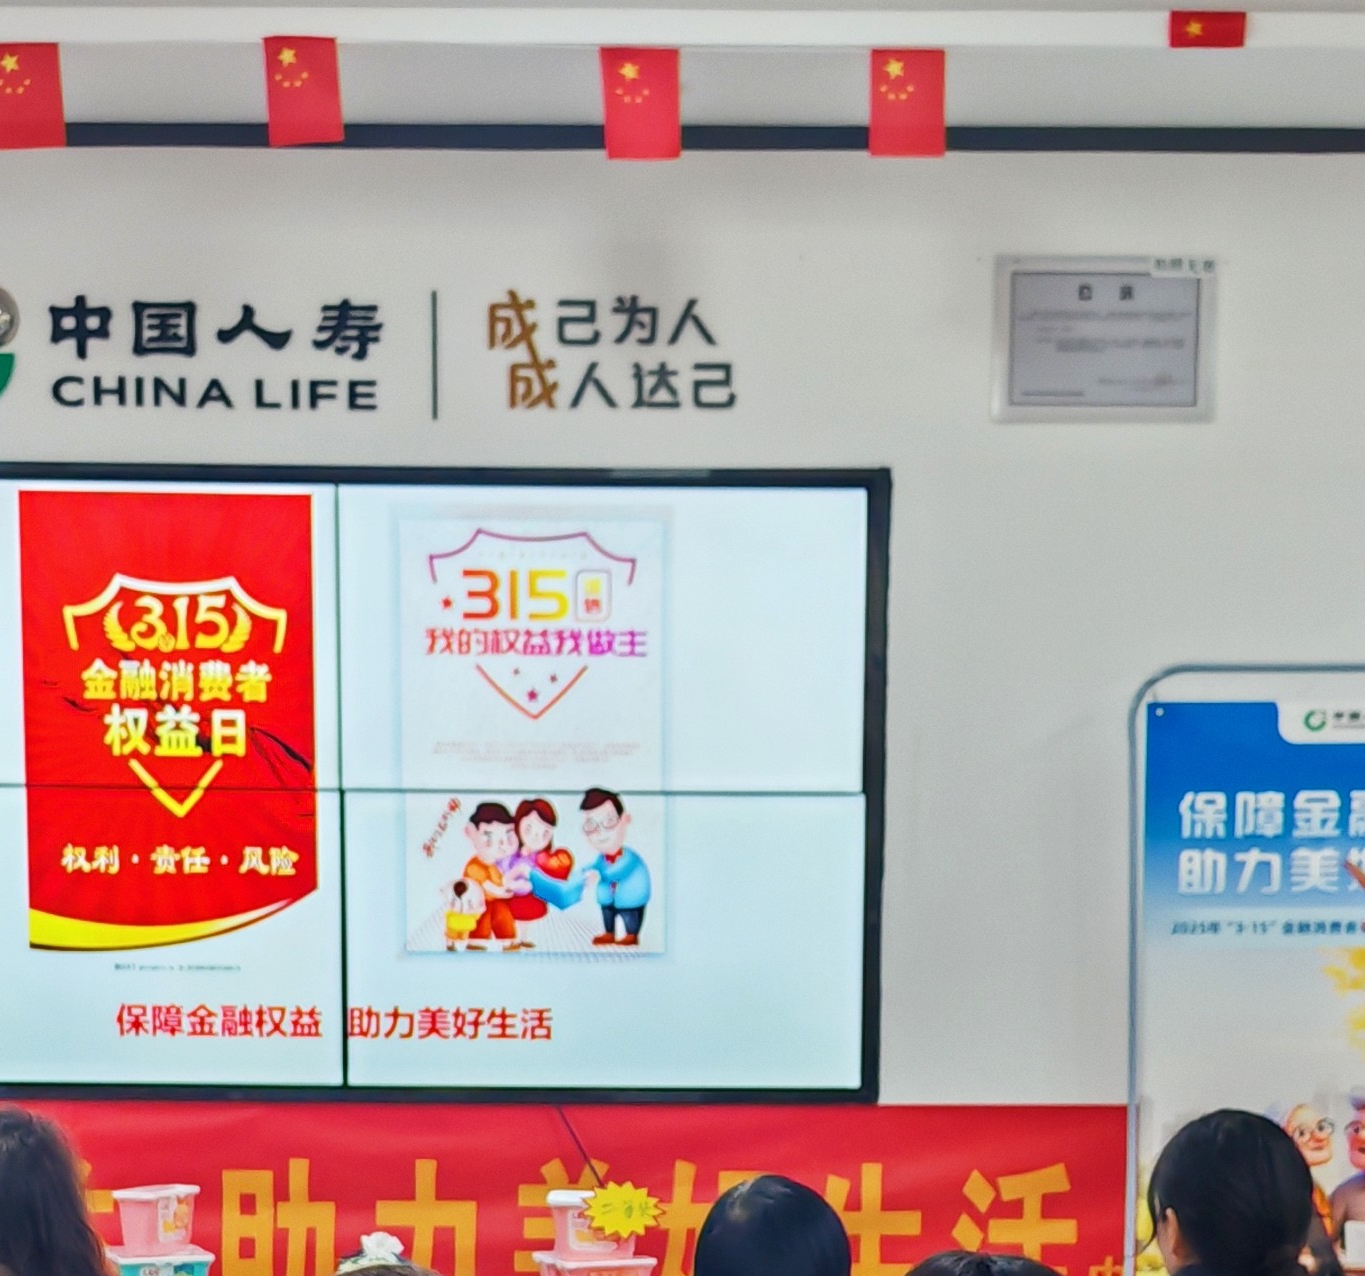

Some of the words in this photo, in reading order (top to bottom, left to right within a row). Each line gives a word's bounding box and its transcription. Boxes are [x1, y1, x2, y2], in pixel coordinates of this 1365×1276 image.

[47, 294, 385, 361] 中国人寿
[488, 289, 718, 352] 成己为人
[51, 376, 235, 410] CHINA
[254, 377, 378, 411] LIFE
[508, 360, 738, 412] 成人达己
[461, 568, 570, 622] 315
[425, 627, 648, 657] 我的权益我做主
[81, 657, 273, 703] 金融消费者
[103, 704, 248, 758] 权益日
[115, 1003, 323, 1039] 保障金融权益
[348, 1006, 554, 1041] 助力美好生活
